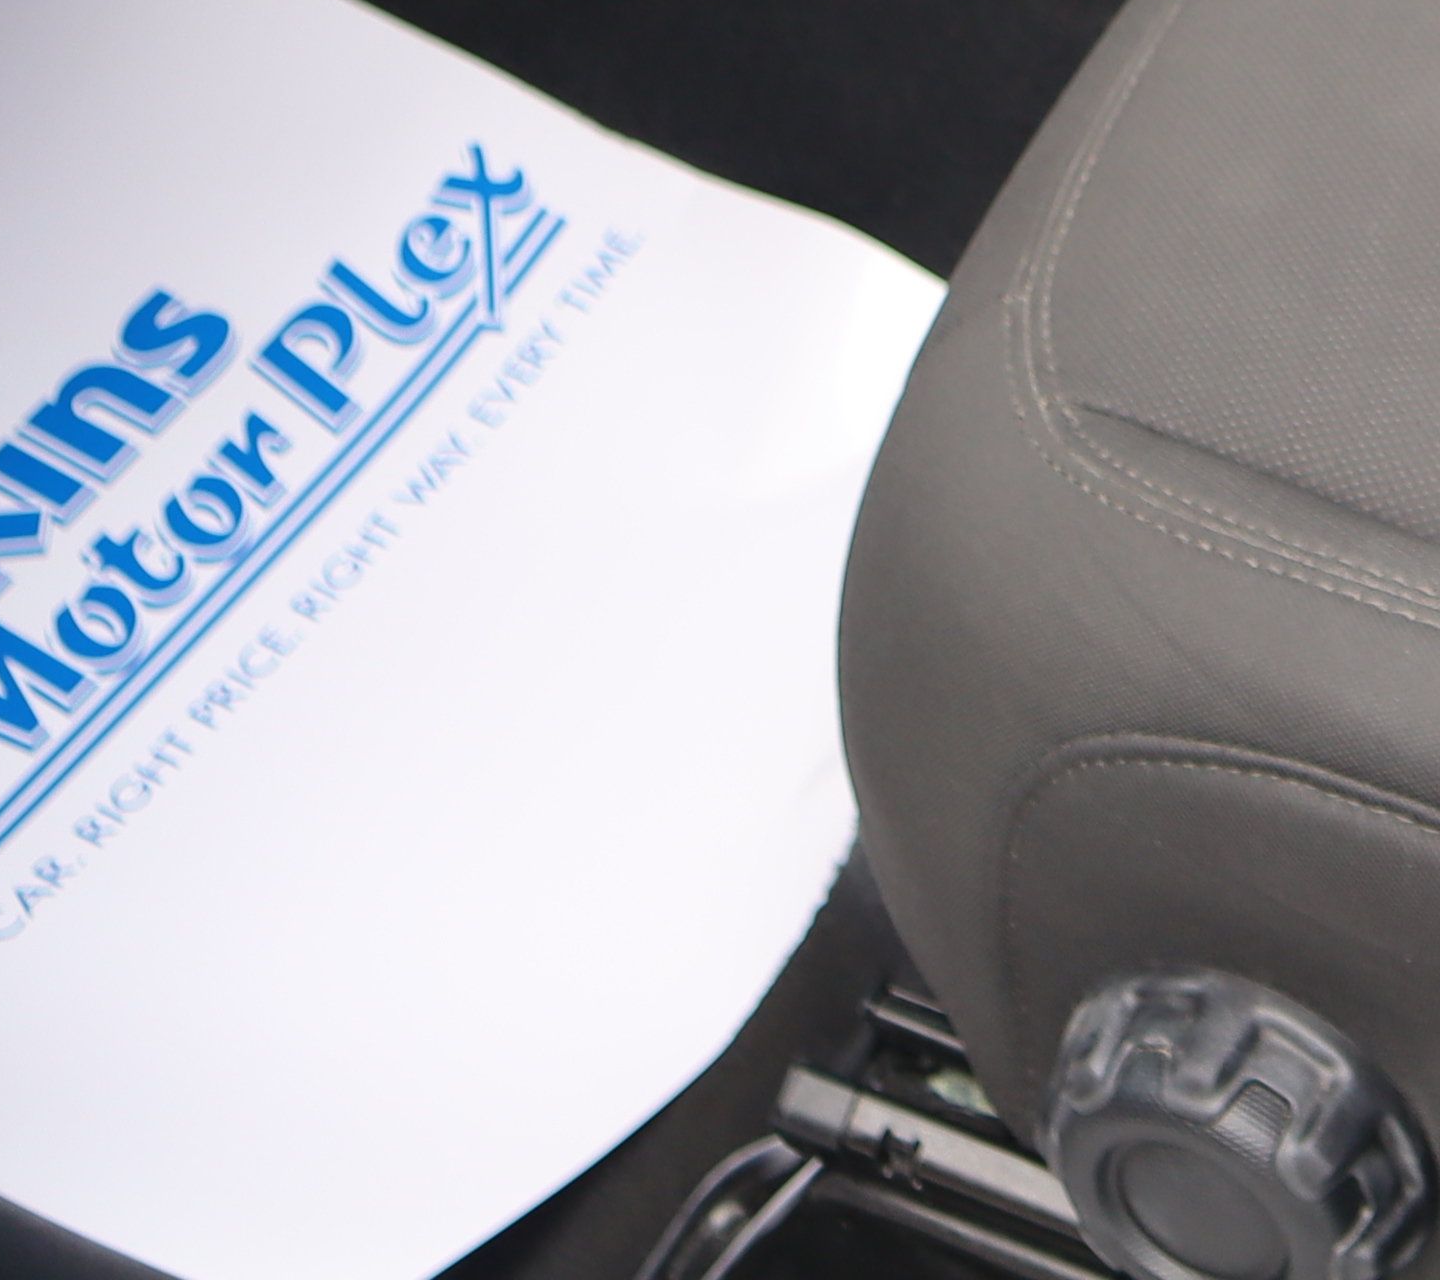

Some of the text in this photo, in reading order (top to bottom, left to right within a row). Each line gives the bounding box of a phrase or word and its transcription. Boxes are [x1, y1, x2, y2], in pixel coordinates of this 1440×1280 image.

[248, 142, 532, 438] Plex
[71, 729, 194, 849] RIGHT
[289, 510, 403, 623] RIGHT
[465, 317, 569, 430] EVERY
